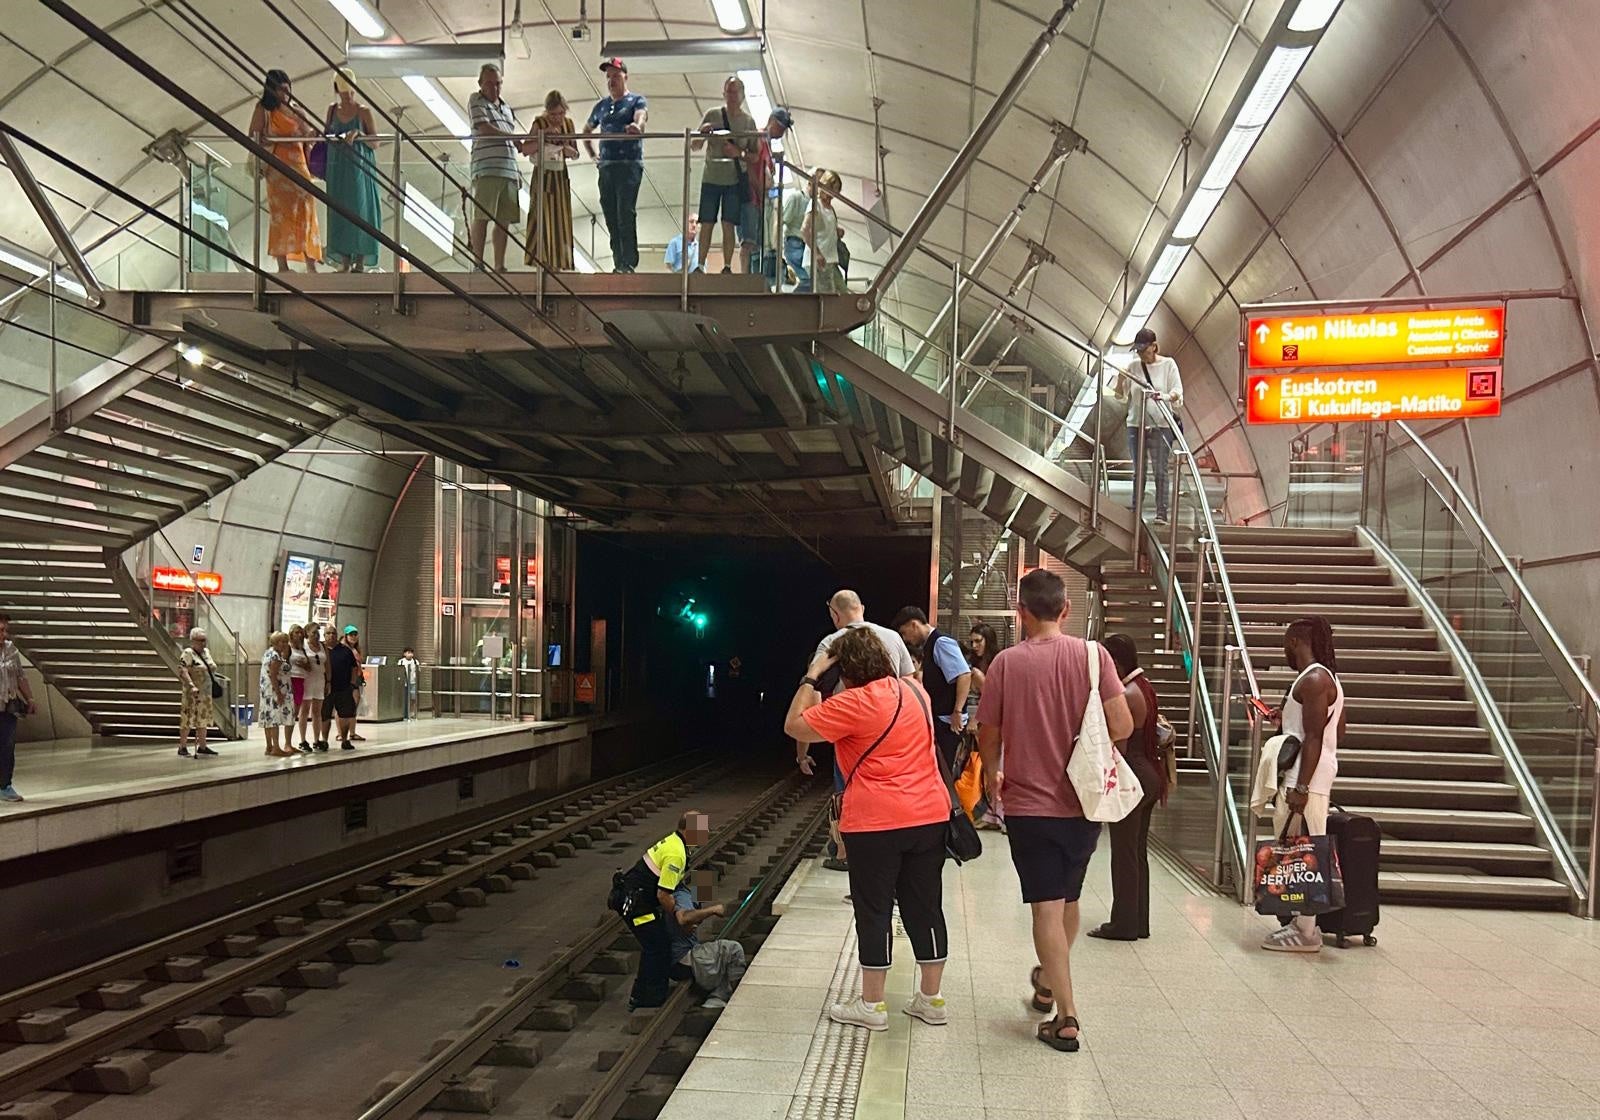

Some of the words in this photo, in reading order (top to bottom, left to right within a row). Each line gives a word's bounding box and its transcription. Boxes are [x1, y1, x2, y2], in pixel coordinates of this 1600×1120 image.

[1281, 321, 1317, 341] San
[1324, 318, 1398, 339] Nikolas
[1455, 343, 1489, 353] Service
[1281, 378, 1377, 397] Euskotren
[1284, 400, 1297, 417] 3
[1308, 395, 1462, 418] Kukullaga-Matiko
[1276, 862, 1307, 875] SUPER
[1260, 871, 1324, 885] BERTAKOA
